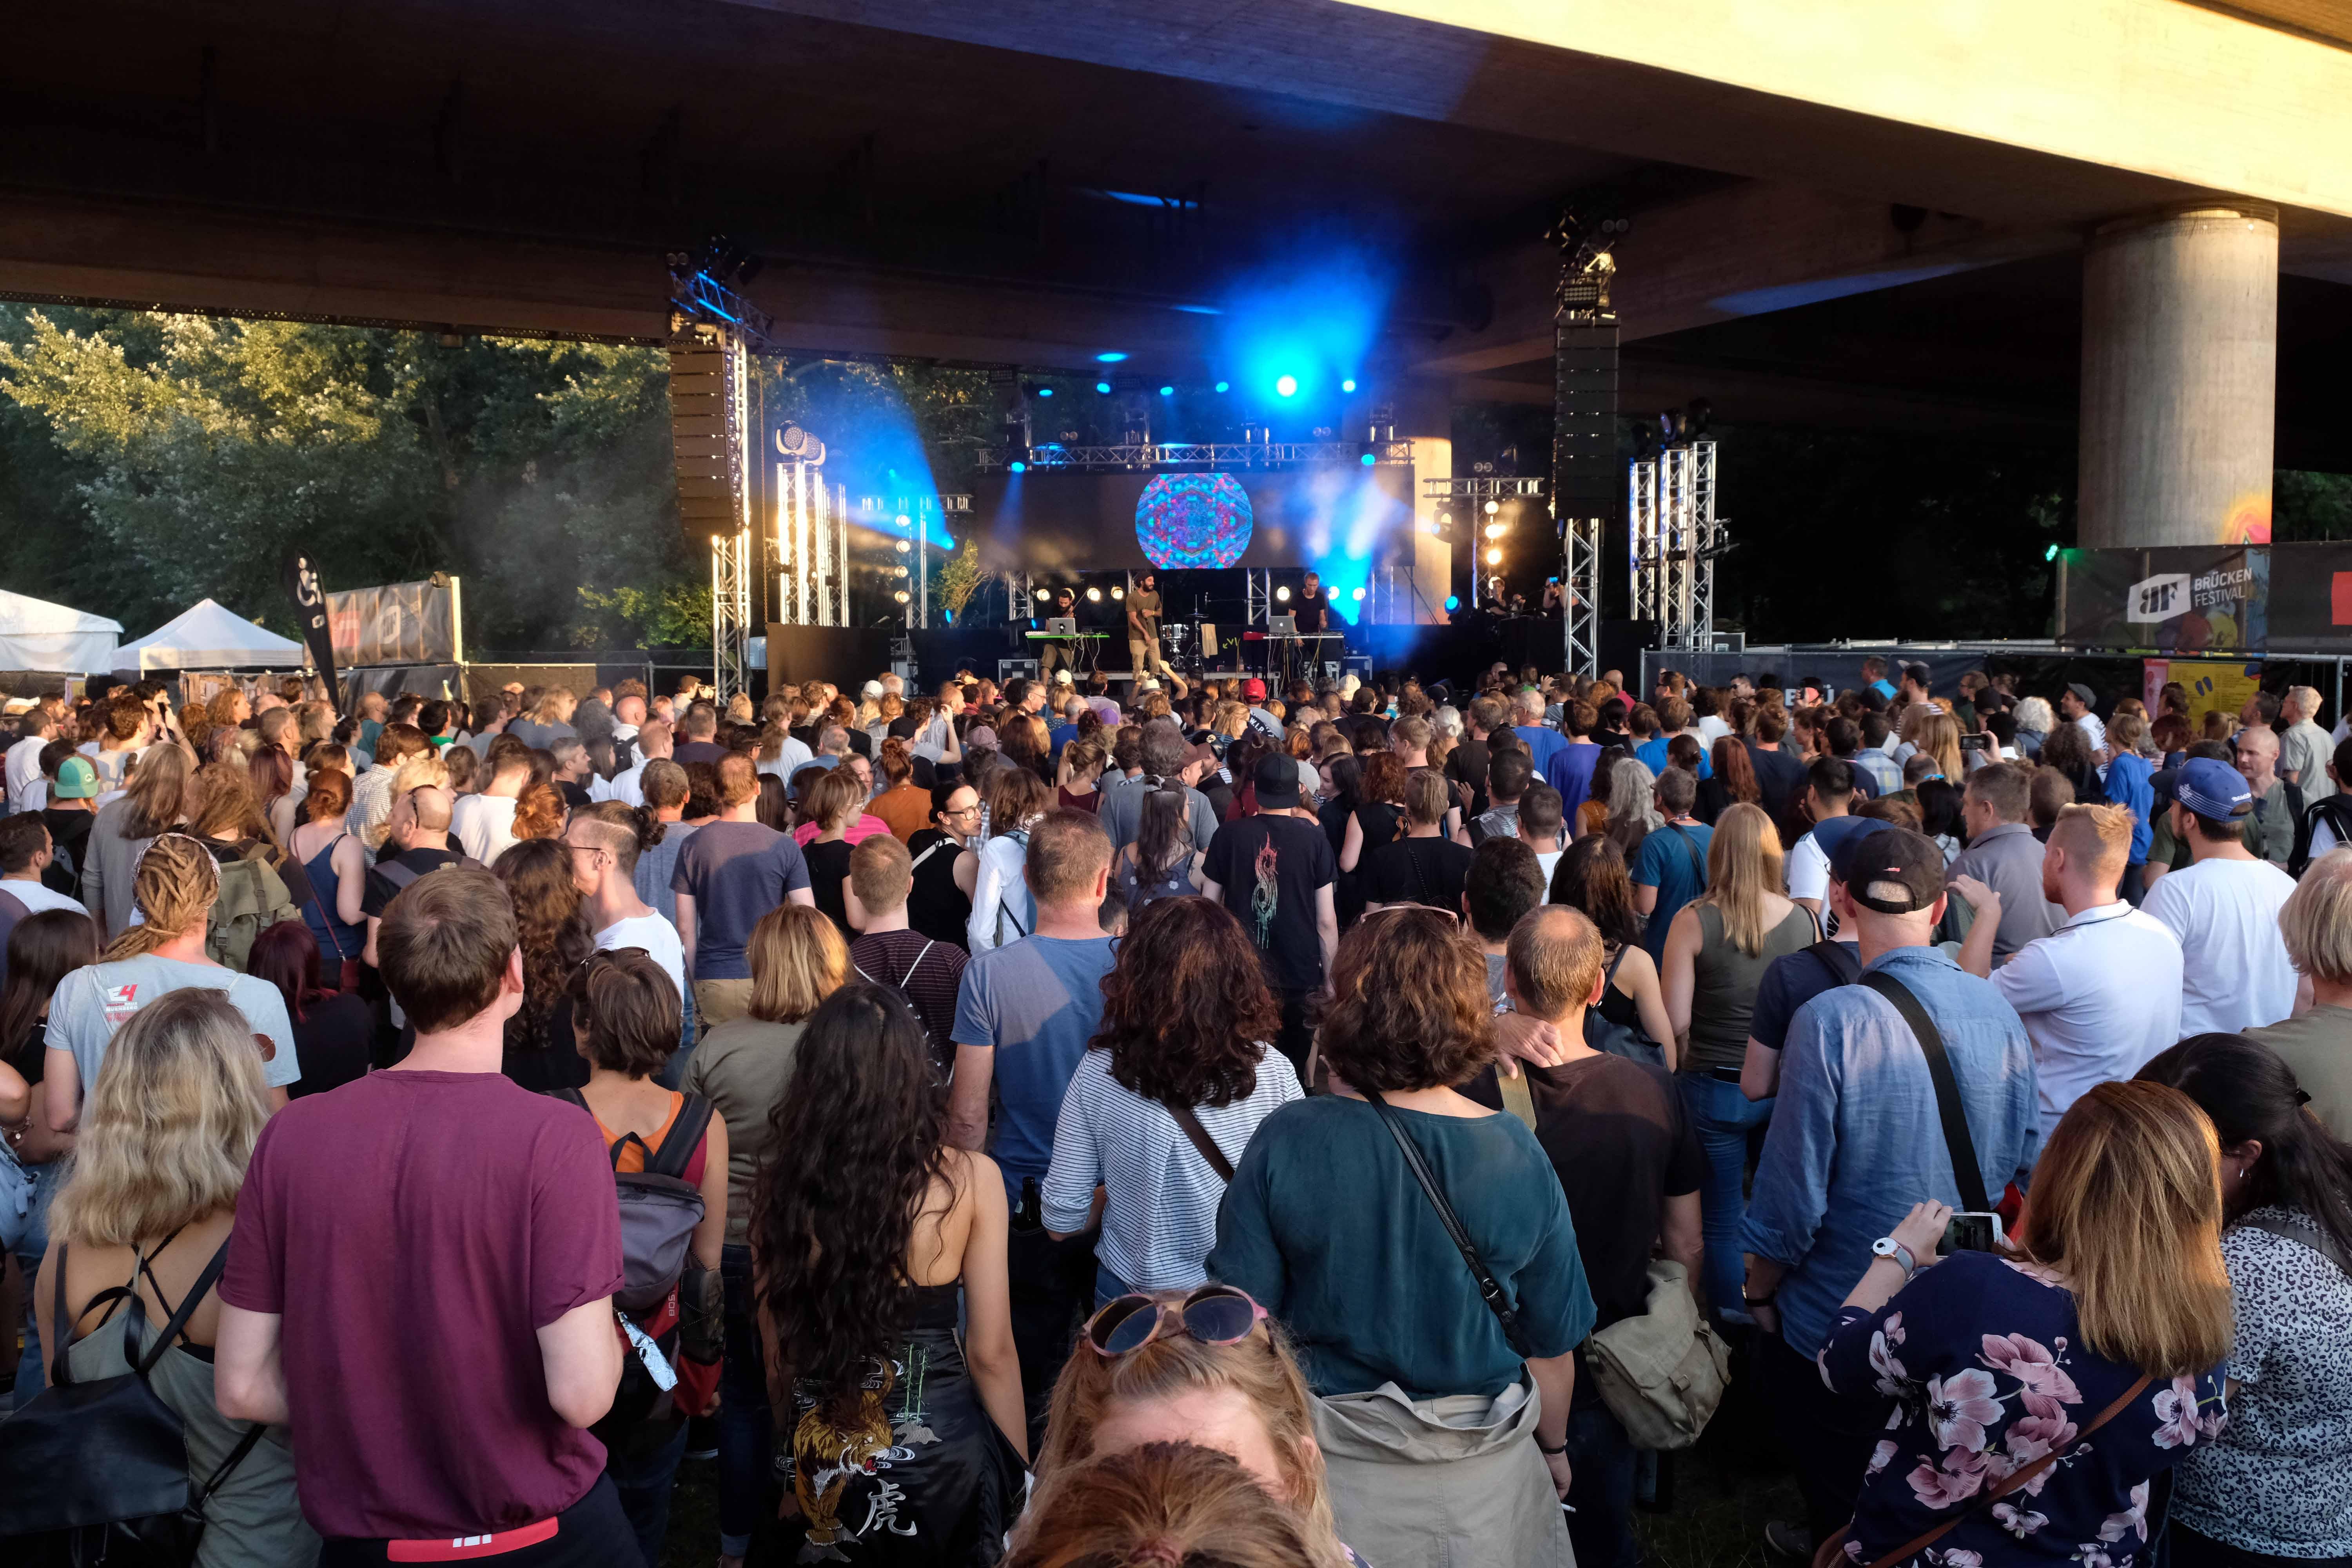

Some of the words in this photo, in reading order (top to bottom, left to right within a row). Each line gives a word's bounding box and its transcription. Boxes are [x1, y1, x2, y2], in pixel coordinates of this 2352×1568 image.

[2194, 567, 2252, 591] BRÜCKEN
[2195, 586, 2246, 607] FESTIVAL
[107, 983, 138, 1002] E4
[856, 1478, 918, 1537] 虎
